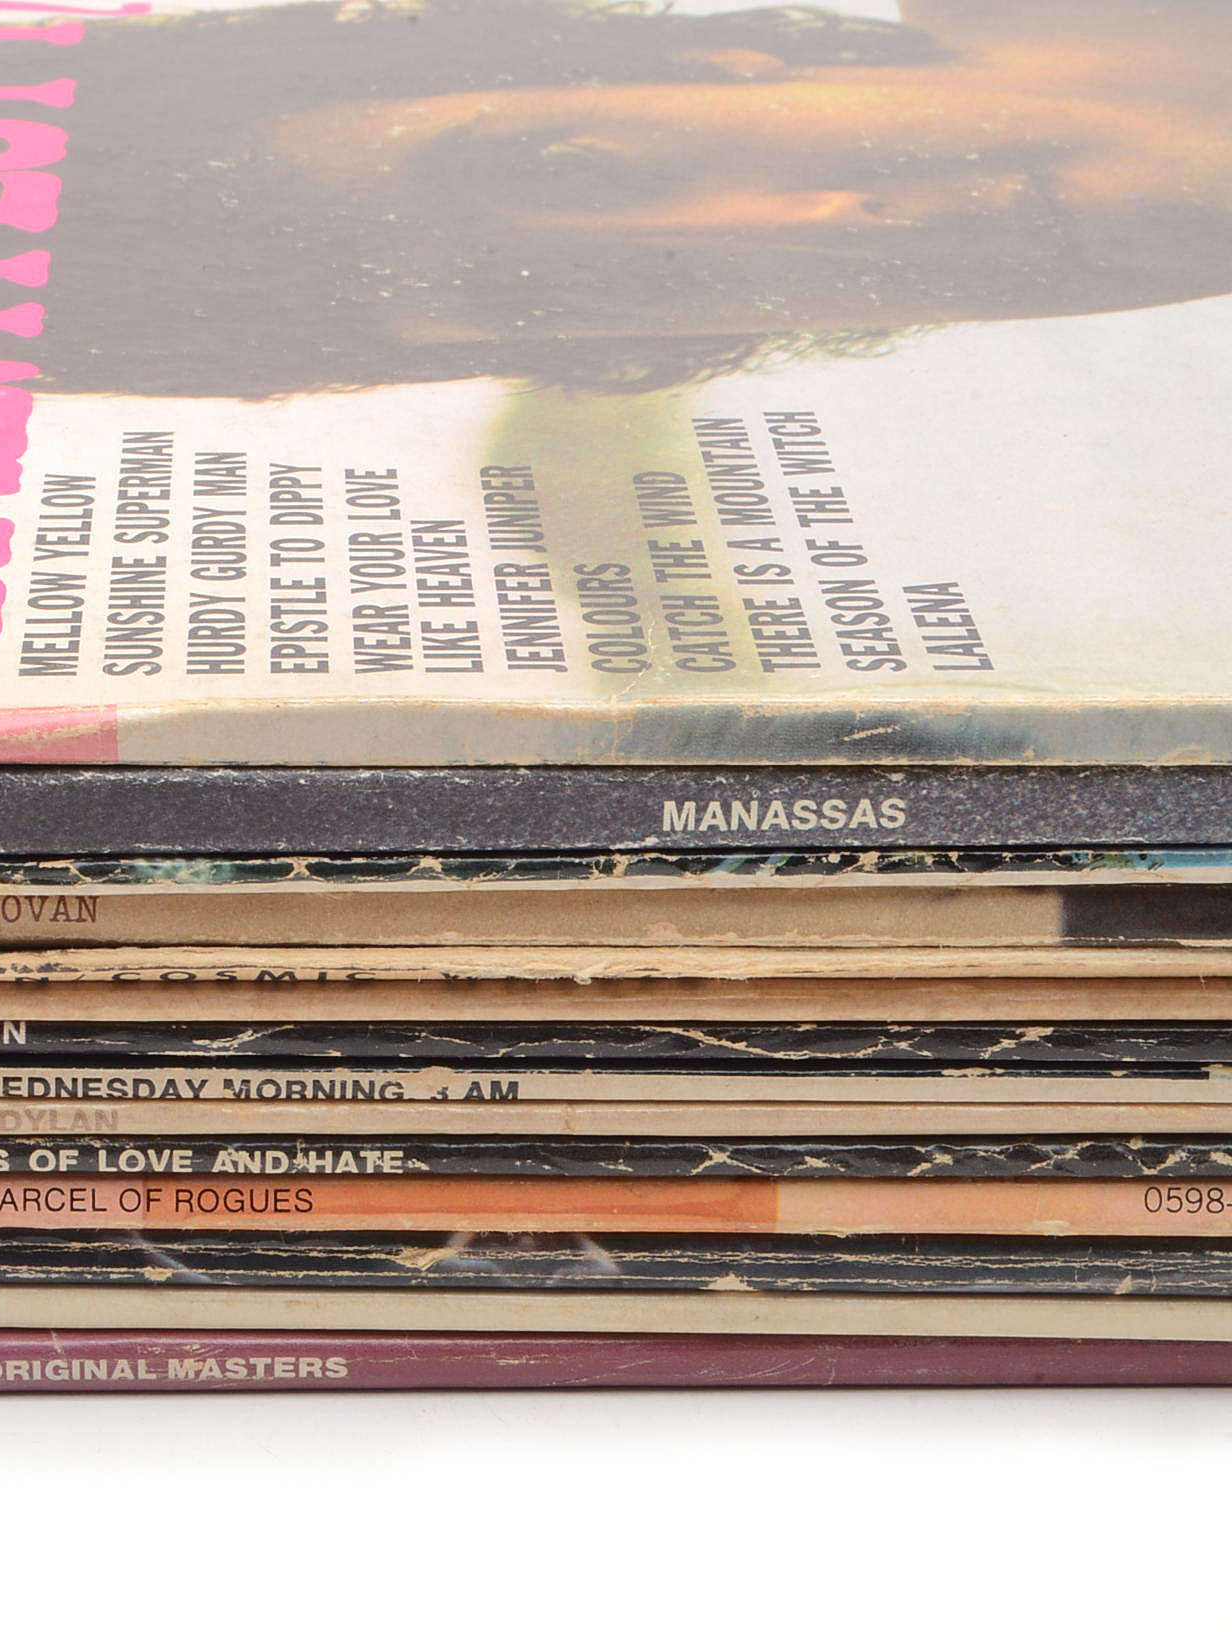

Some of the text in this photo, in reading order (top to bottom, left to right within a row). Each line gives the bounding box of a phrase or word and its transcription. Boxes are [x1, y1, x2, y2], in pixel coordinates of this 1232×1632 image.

[18, 474, 96, 676] MELLOW YELLOW
[102, 431, 174, 676] SUNSHINE SUPERMAN
[186, 452, 247, 674] HURDY GURDY MAN
[269, 462, 329, 674] EPISTLE TO DIPPY
[345, 469, 413, 674] WEAR YOUR LOVE
[410, 520, 484, 673] LIKE HEAVEN
[480, 465, 568, 673] JENNIFER JUNIPER
[573, 563, 652, 673] COLOURS
[633, 471, 737, 672] CATCH THE WIND
[692, 418, 821, 673] THERE IS A MOUNTAIN
[763, 412, 907, 672] SEASON OF THE WITCH
[902, 582, 994, 671] LALENA
[661, 796, 907, 832] MANASSAS
[28, 1148, 79, 1172] OF
[97, 1149, 194, 1173] LOVE
[211, 1149, 289, 1174] AND
[308, 1150, 405, 1174] HATE
[464, 1080, 519, 1100] AM
[119, 1187, 163, 1213] OF
[175, 1188, 314, 1214] ROGUES
[168, 1357, 349, 1381] MASTERS
